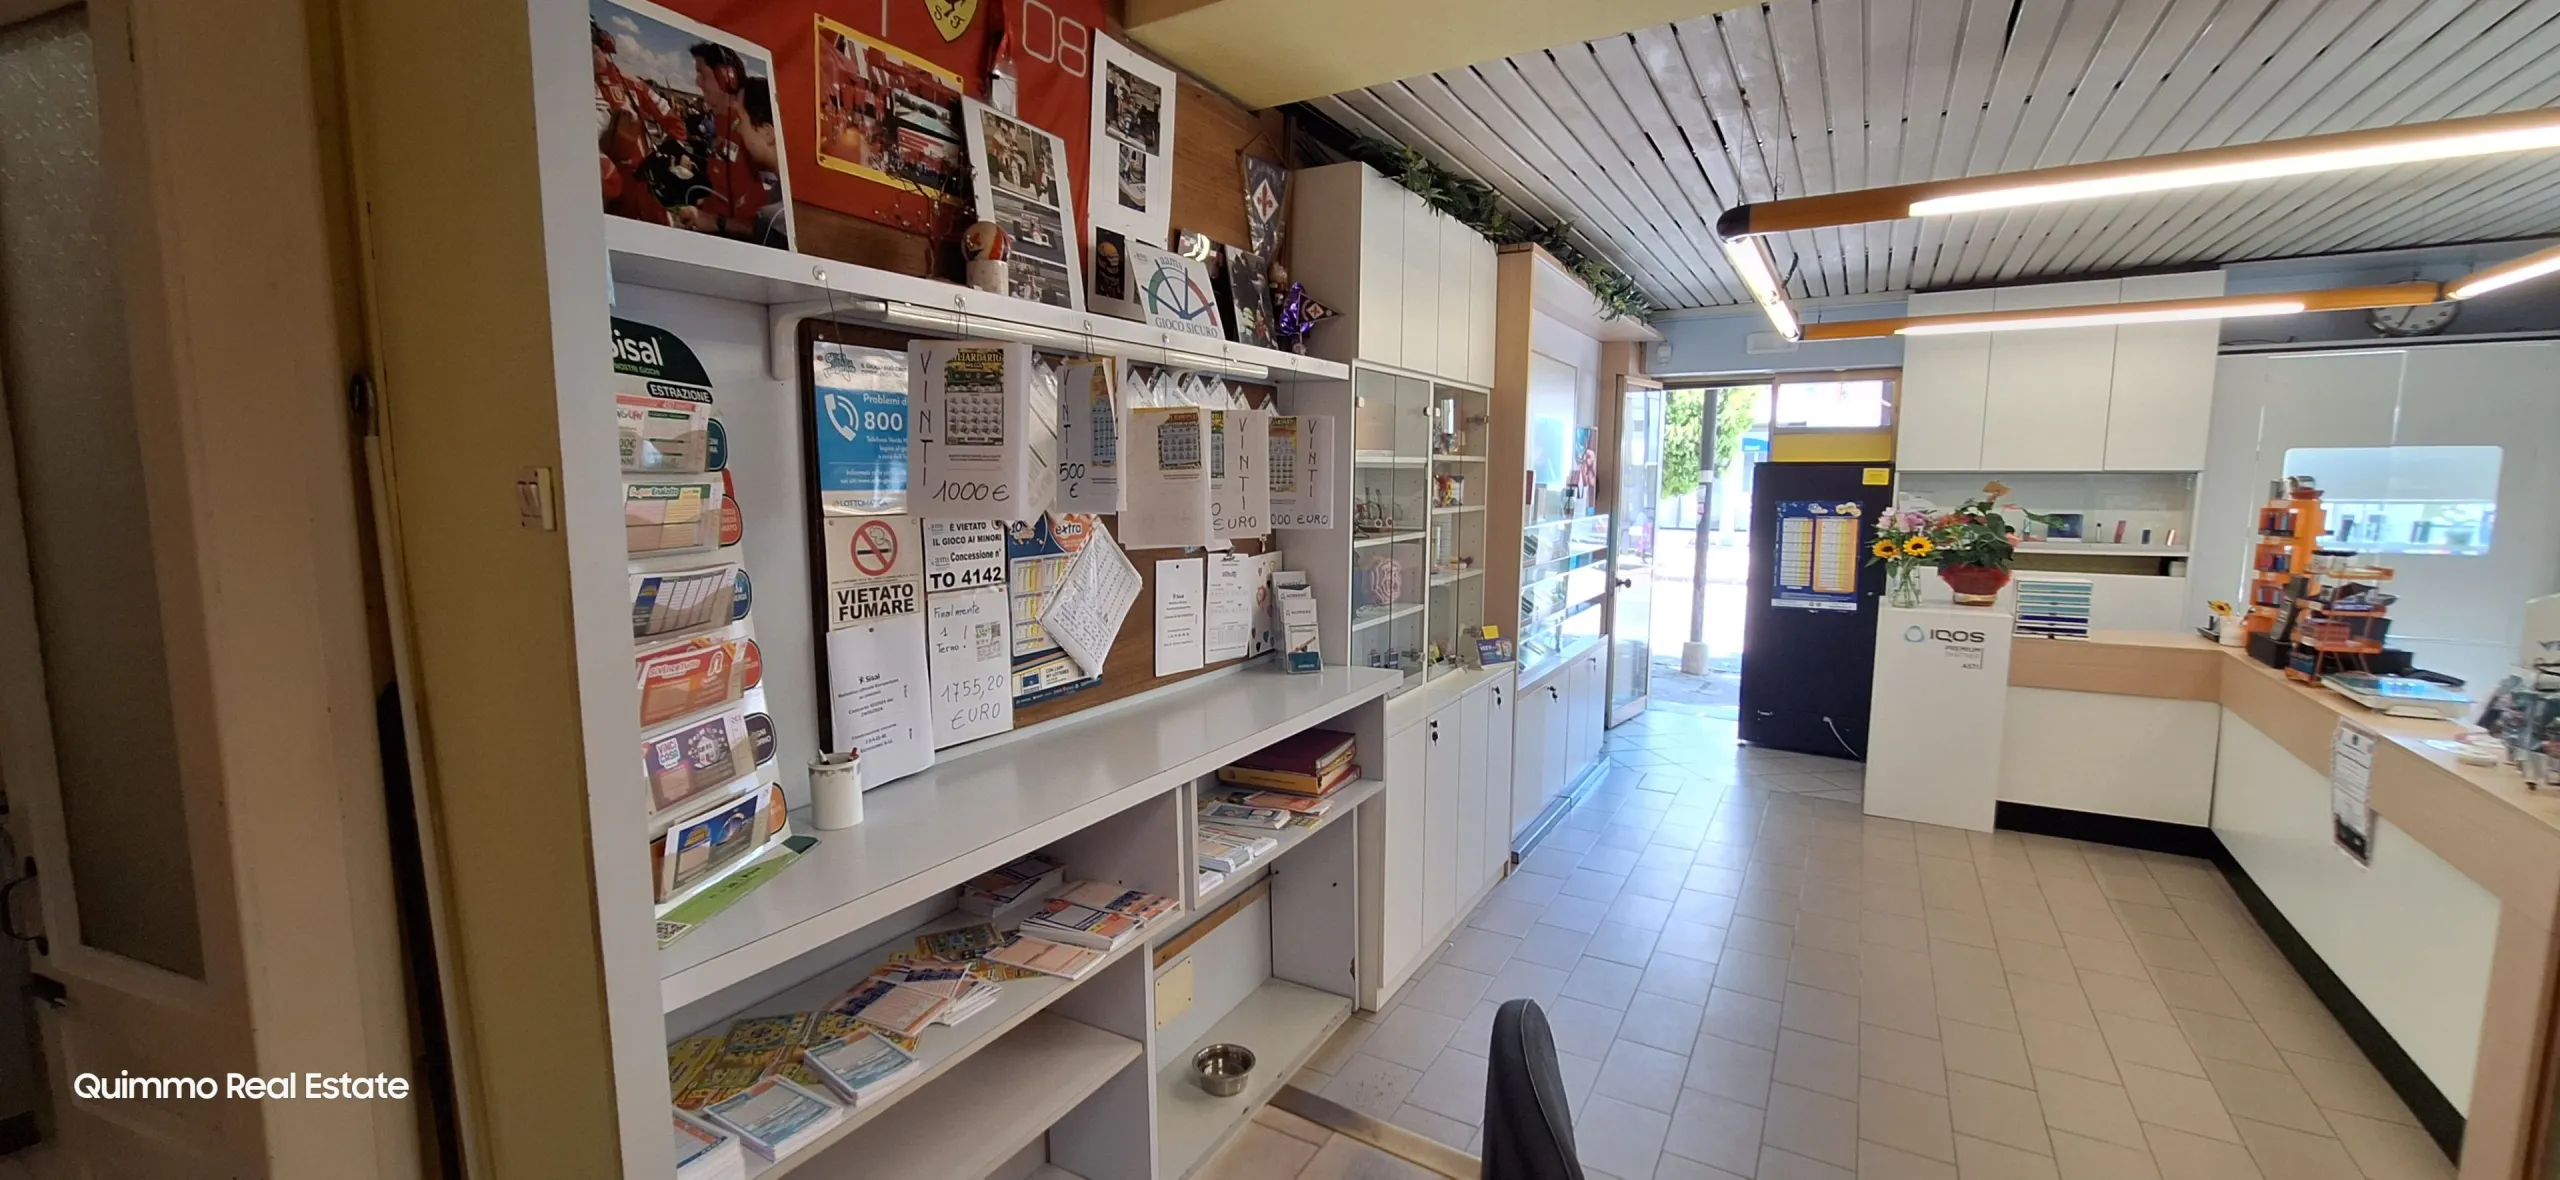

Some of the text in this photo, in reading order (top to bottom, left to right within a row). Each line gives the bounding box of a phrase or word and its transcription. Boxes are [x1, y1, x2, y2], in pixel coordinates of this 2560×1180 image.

[1155, 317, 1218, 337] GIOCO SICURO
[650, 384, 711, 402] ESTRAZIONE
[863, 393, 898, 405] Problemi
[864, 411, 903, 431] 800
[919, 350, 934, 487] VINTI
[1062, 368, 1072, 460] VINTI
[1238, 417, 1249, 511] VINTI
[1308, 419, 1318, 498] VINTI
[1059, 463, 1085, 482] 500
[1069, 483, 1079, 498] €
[956, 522, 987, 531] VIETATO
[1212, 516, 1257, 531] EURO
[1270, 513, 1329, 525] 000 EURO
[1055, 522, 1082, 535] extra
[932, 534, 1002, 546] IL GIOCO AI MINORI
[950, 550, 994, 562] Concessione
[929, 572, 955, 589] TO
[961, 566, 1002, 585] 4142
[837, 583, 914, 606] VIETATO
[839, 598, 914, 621] FUMARE
[933, 601, 980, 619] Finalmente
[1930, 629, 1985, 643] IQOS
[936, 642, 960, 654] Terno
[865, 673, 880, 682] Sisal
[941, 674, 1004, 703] 1755,20
[951, 702, 1001, 731] EURO
